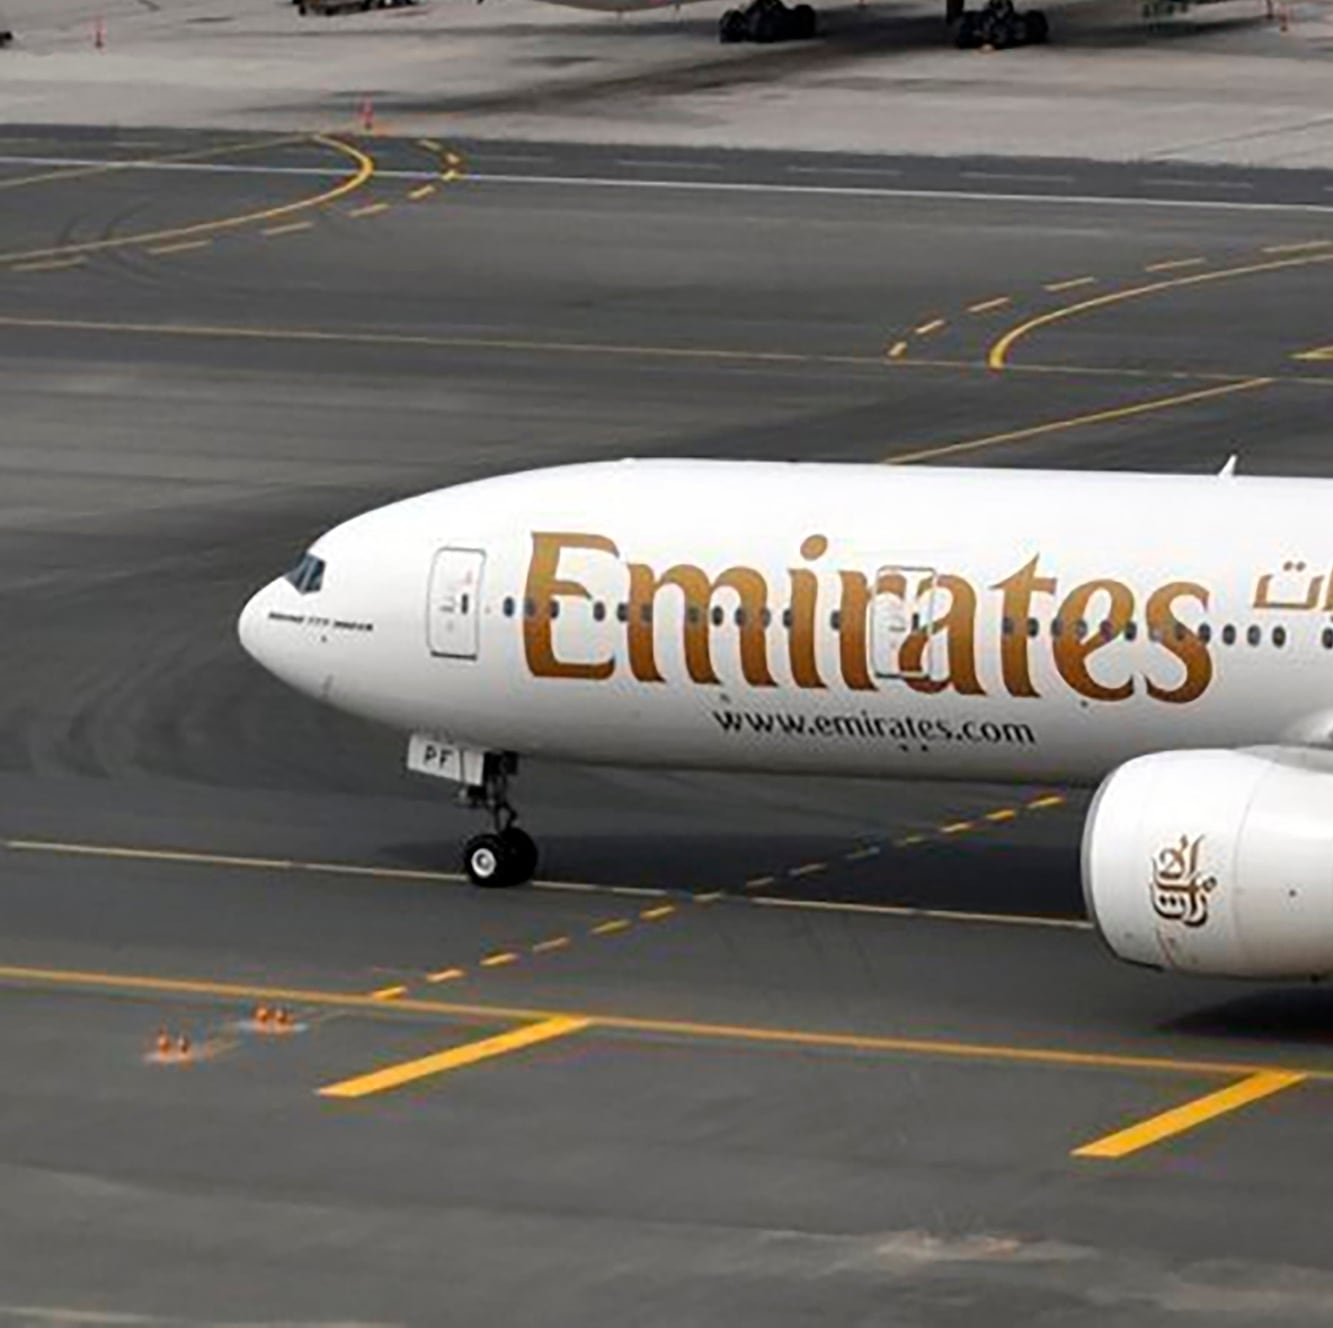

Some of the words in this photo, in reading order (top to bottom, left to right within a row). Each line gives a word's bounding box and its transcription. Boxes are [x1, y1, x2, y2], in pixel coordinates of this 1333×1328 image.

[522, 531, 1214, 706] Emirates
[711, 709, 1037, 746] www.emirates.com
[424, 744, 454, 769] PF
